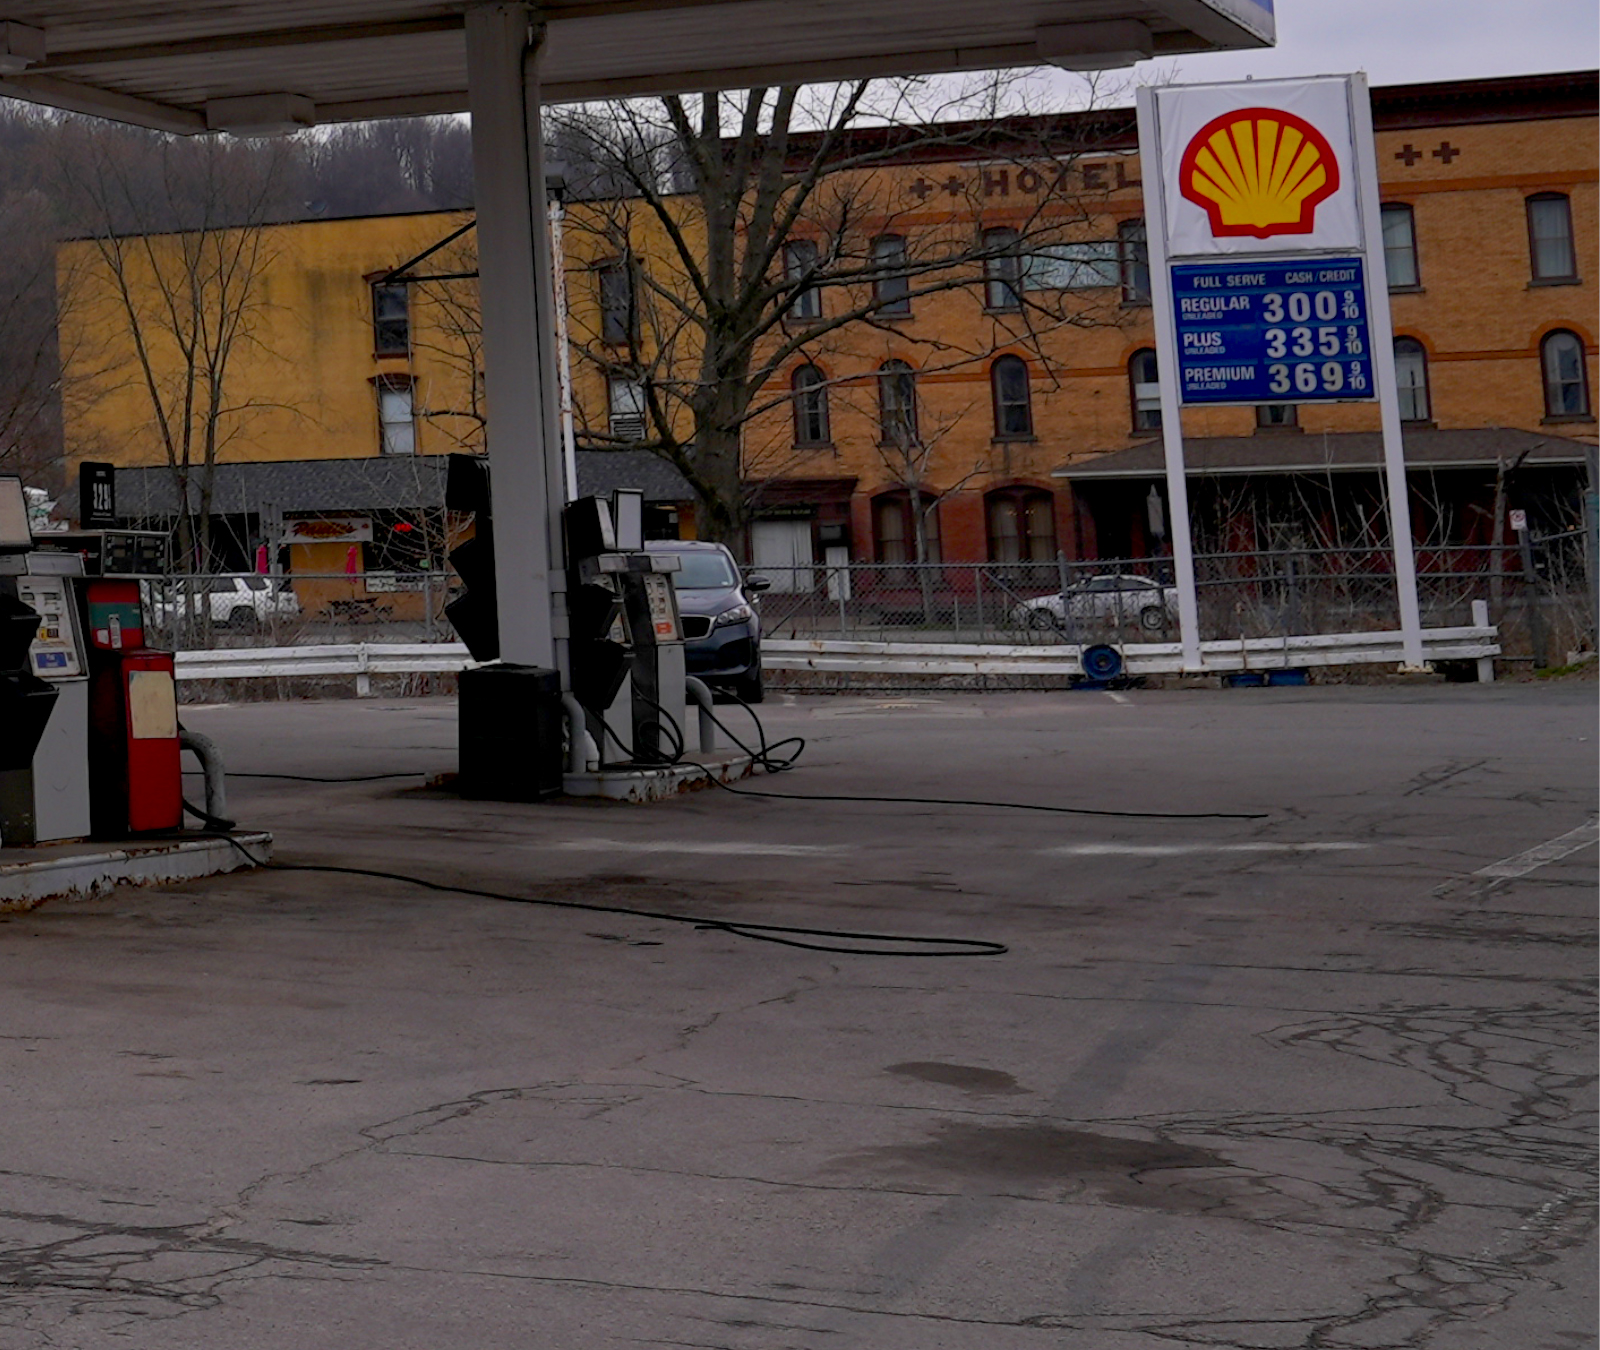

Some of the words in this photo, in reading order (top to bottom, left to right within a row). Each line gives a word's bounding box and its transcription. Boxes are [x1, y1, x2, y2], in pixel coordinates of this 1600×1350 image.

[983, 162, 1142, 196] HOTEL
[1193, 276, 1222, 288] FULL
[1226, 274, 1266, 286] SERVE
[1181, 296, 1250, 312] REGULAR
[1262, 291, 1337, 323] 300
[1183, 332, 1222, 347] PLUS
[1265, 326, 1340, 358] 335
[1185, 366, 1255, 382] PREMIUM
[1268, 361, 1344, 393] 369
